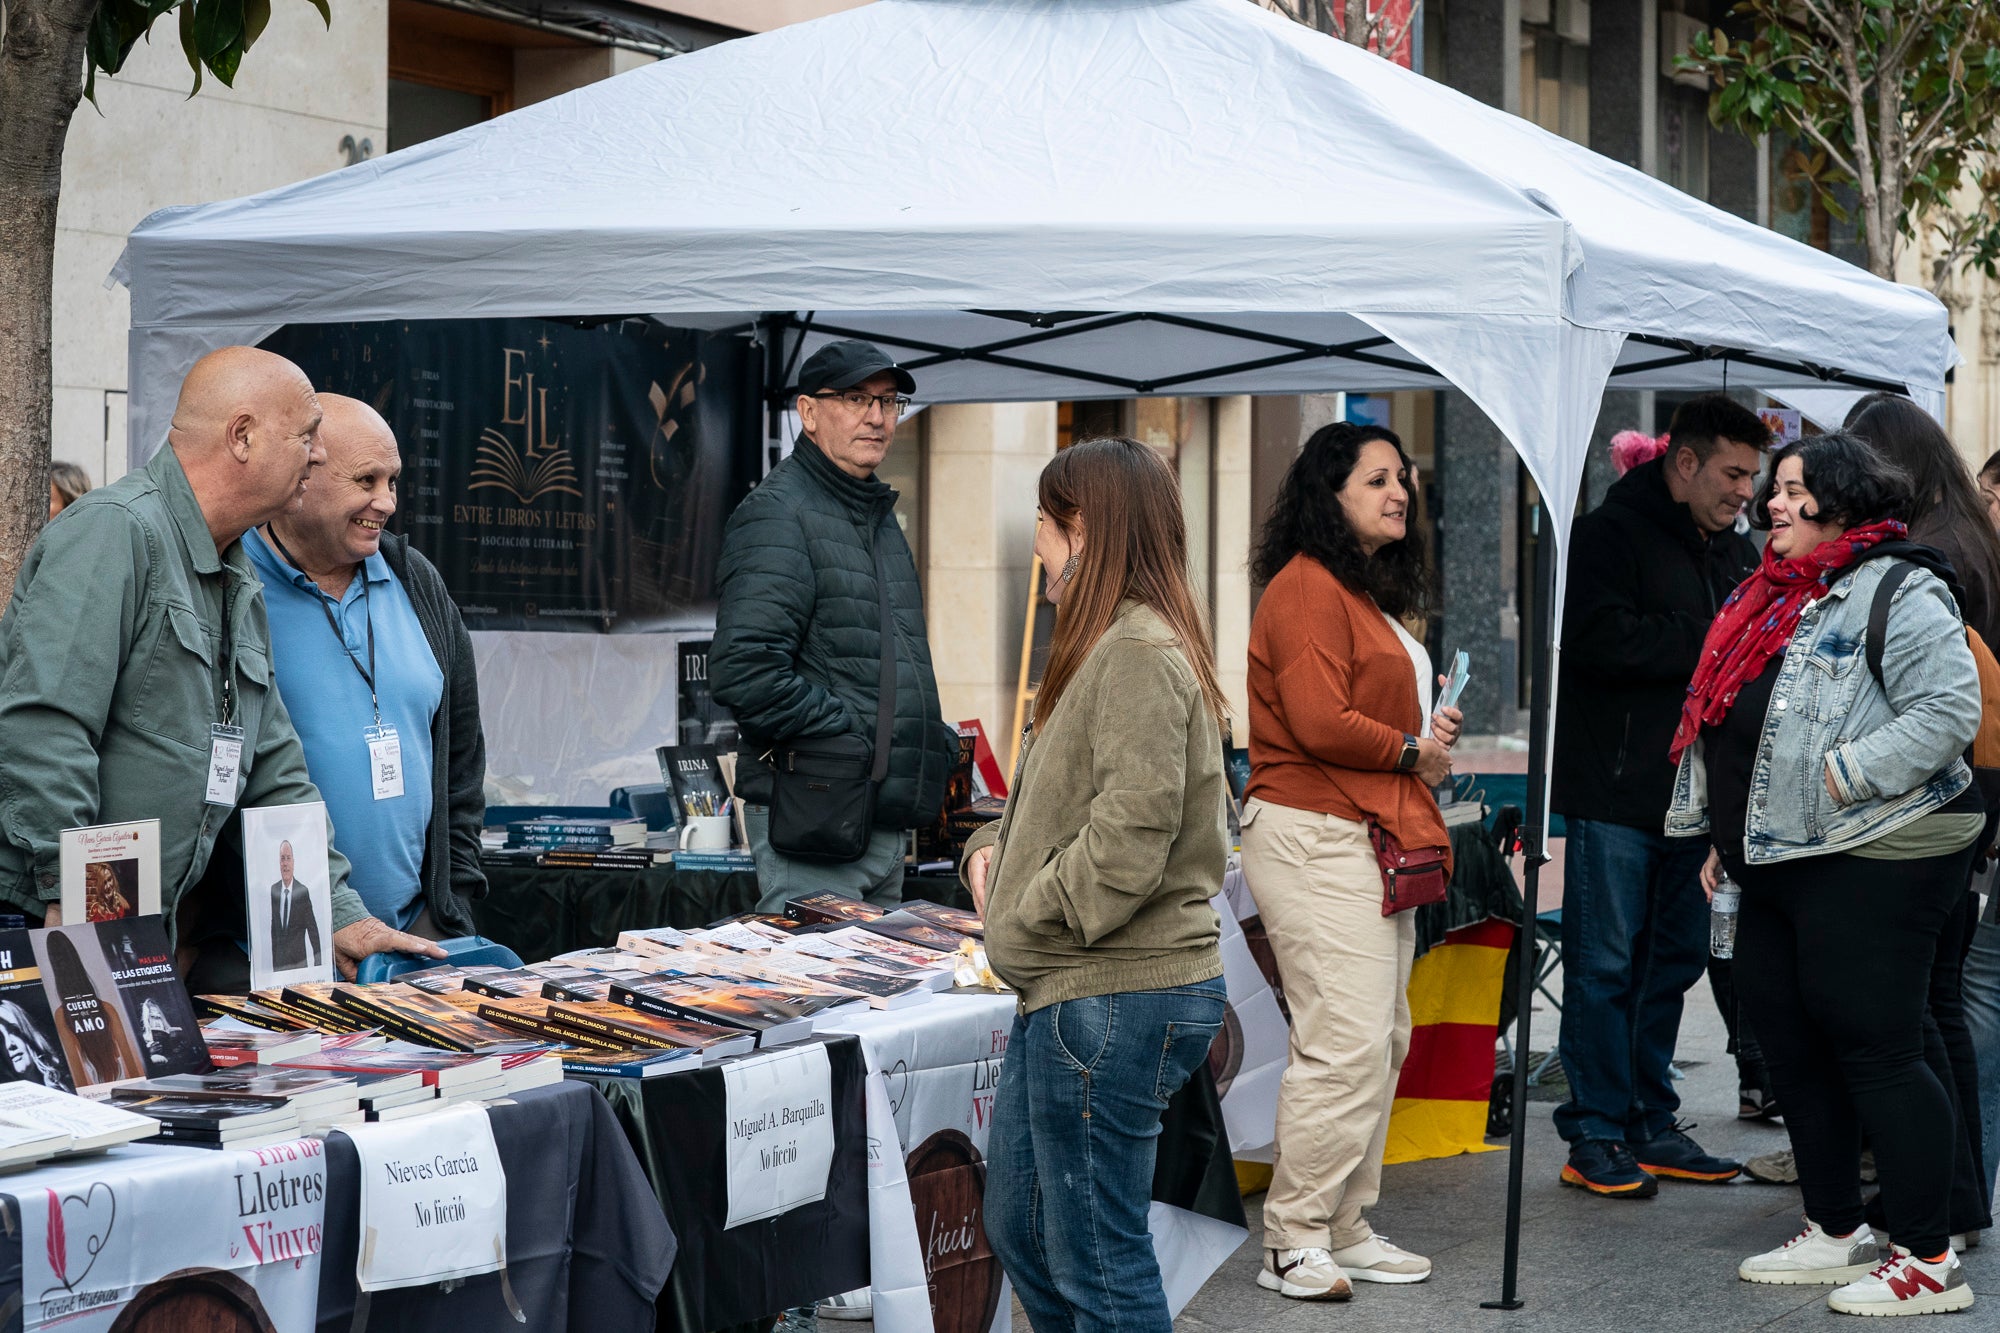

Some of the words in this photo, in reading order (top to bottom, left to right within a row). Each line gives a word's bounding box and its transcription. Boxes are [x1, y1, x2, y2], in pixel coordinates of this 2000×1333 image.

[454, 504, 493, 525] ENTRE
[498, 507, 541, 528] LIBROS
[544, 510, 553, 529] Y
[556, 511, 597, 530] LETRAS
[685, 654, 708, 682] IRI
[678, 759, 709, 772] IRINA
[111, 971, 122, 980] DE
[122, 968, 136, 979] LAS
[135, 964, 172, 977] ETIQUETAS
[66, 999, 98, 1012] CUERPO
[641, 1000, 664, 1012] APRENDER
[684, 1014, 700, 1023] MIGUEL
[74, 1017, 105, 1033] AMO
[496, 1010, 507, 1020] DÍAS
[507, 1014, 538, 1028] INCLINADOS
[543, 1025, 562, 1035] MIGUEL
[562, 1029, 579, 1040] ÁNGEL
[579, 1034, 608, 1047] BARQUILLA
[607, 1042, 623, 1051] ARIAS
[554, 1011, 565, 1019] LOS
[565, 1013, 577, 1023] DÍAS
[577, 1017, 607, 1031] INCLINADOS
[613, 1028, 632, 1039] MIGUEL
[632, 1032, 649, 1044] ÁNGEL
[991, 1029, 1009, 1054] Fir
[570, 1063, 585, 1071] ÁNGEL
[585, 1065, 609, 1073] BARQUILLA
[733, 1112, 766, 1140] Miguel
[768, 1112, 779, 1130] A.
[781, 1099, 825, 1126] Barquilla
[384, 1160, 433, 1185] Nieves
[434, 1151, 479, 1177] García
[760, 1148, 771, 1172] No
[773, 1140, 797, 1168] ficció
[234, 1170, 323, 1217] Lletres
[414, 1201, 431, 1228] No
[434, 1195, 466, 1225] ficció
[242, 1221, 321, 1270] Vinyes
